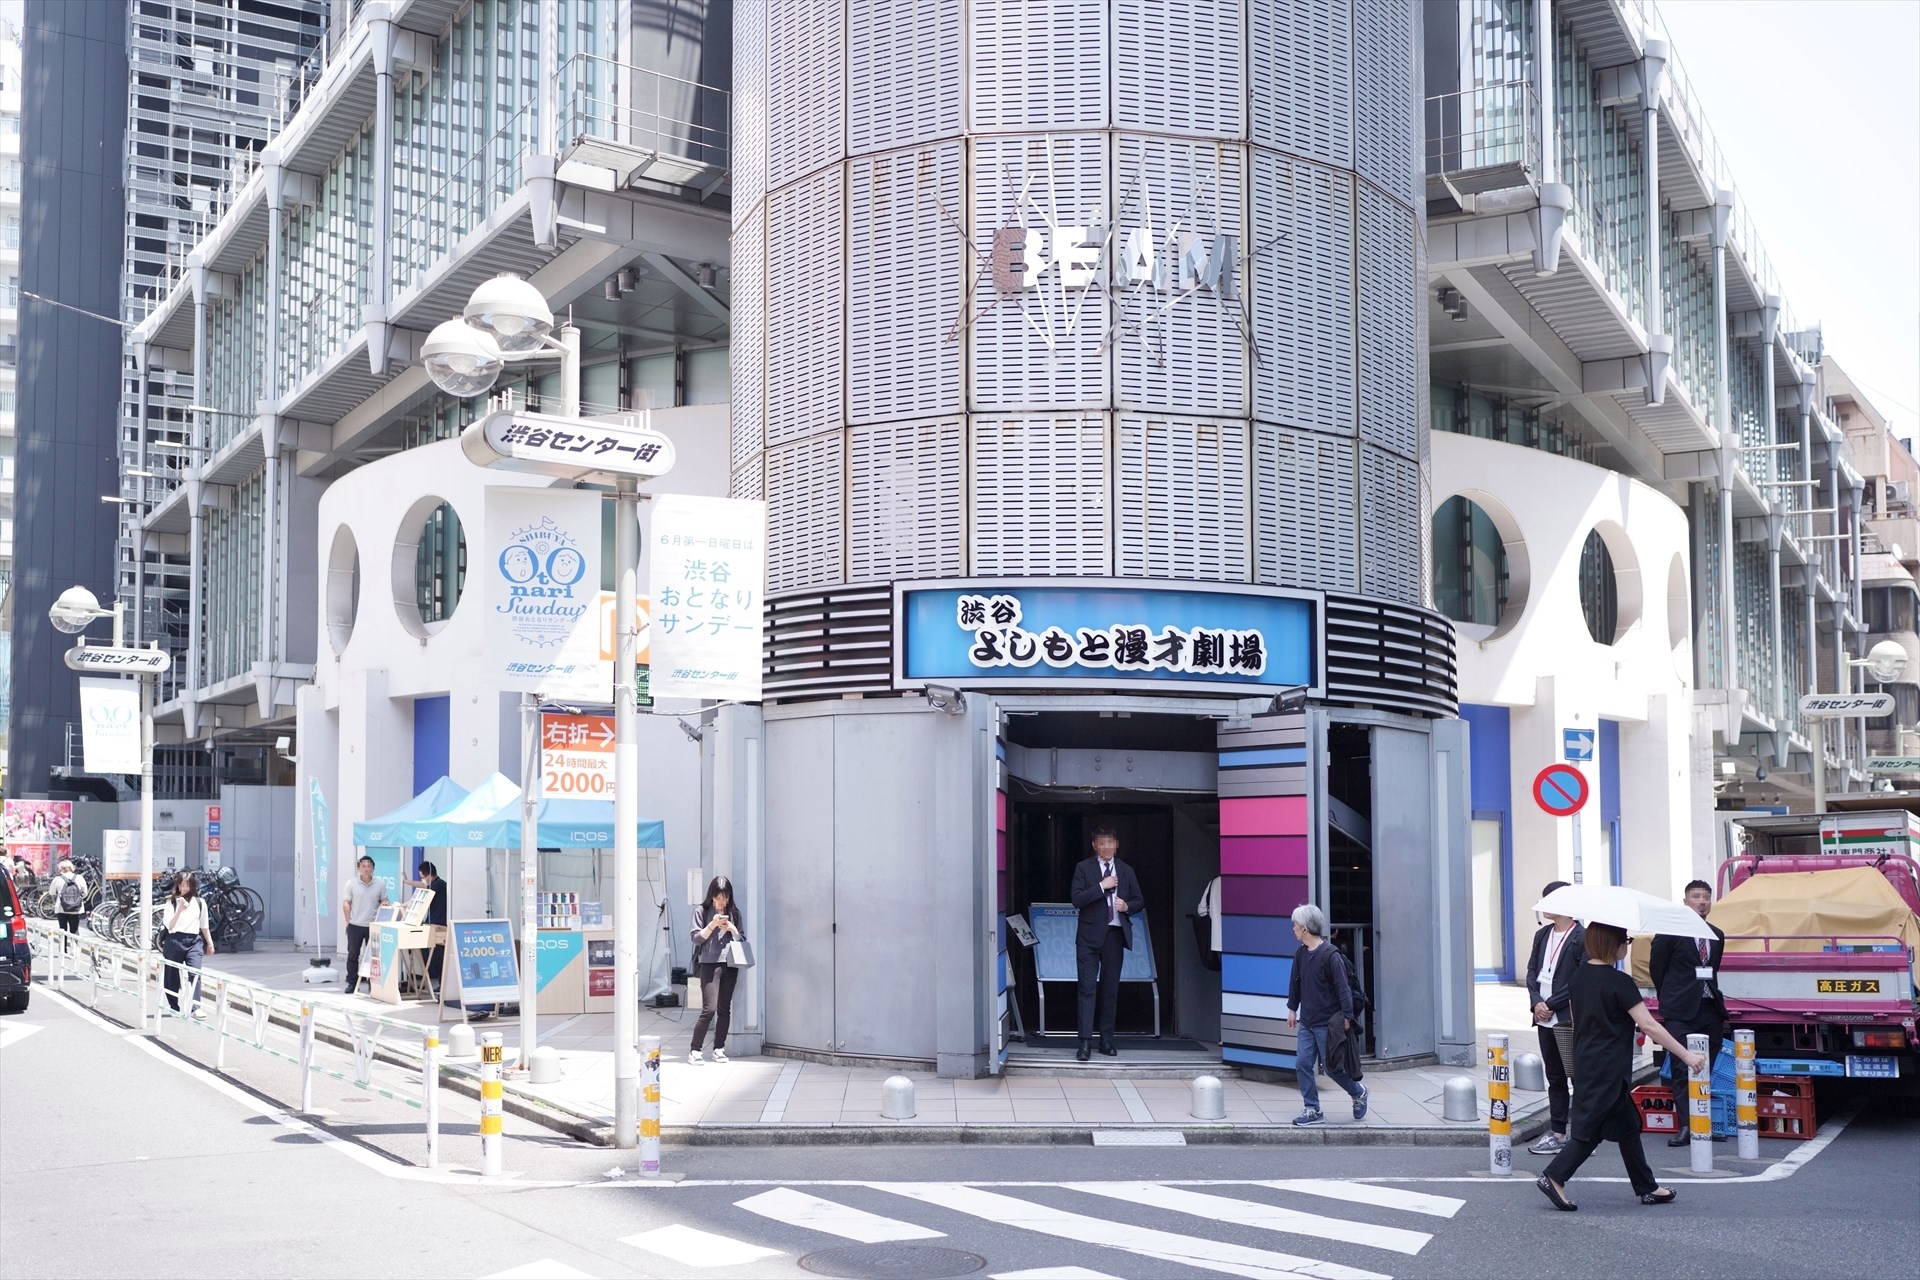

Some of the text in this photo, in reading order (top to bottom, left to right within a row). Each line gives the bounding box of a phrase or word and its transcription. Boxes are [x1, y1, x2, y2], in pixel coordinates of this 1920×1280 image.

[992, 226, 1239, 296] BEAM
[499, 423, 663, 463] 渋谷センター街
[518, 531, 566, 547] SHIBUYA
[660, 535, 754, 550] 6月第一日曜日は
[684, 559, 731, 583] 渋谷
[660, 586, 752, 610] おとなり
[496, 597, 588, 623] Sunday
[961, 600, 1017, 625] 渋谷
[658, 613, 753, 636] サンデー
[973, 628, 1263, 670] よしもと漫才劇場
[77, 651, 162, 667] 渋谷センター街
[506, 662, 577, 674] 渋谷センター街
[671, 669, 739, 681] 渋谷センター街
[1805, 699, 1887, 710] 渋谷センター街
[546, 721, 589, 745] 右折
[545, 753, 608, 769] 24時間最大
[1869, 760, 1920, 769] 渋谷センター
[370, 832, 383, 841] IQOS
[416, 831, 429, 841] IQOS
[468, 831, 483, 841] IQOS
[570, 831, 608, 843] IQOS
[536, 939, 569, 950] QOS
[1820, 981, 1877, 991] 高圧ガス
